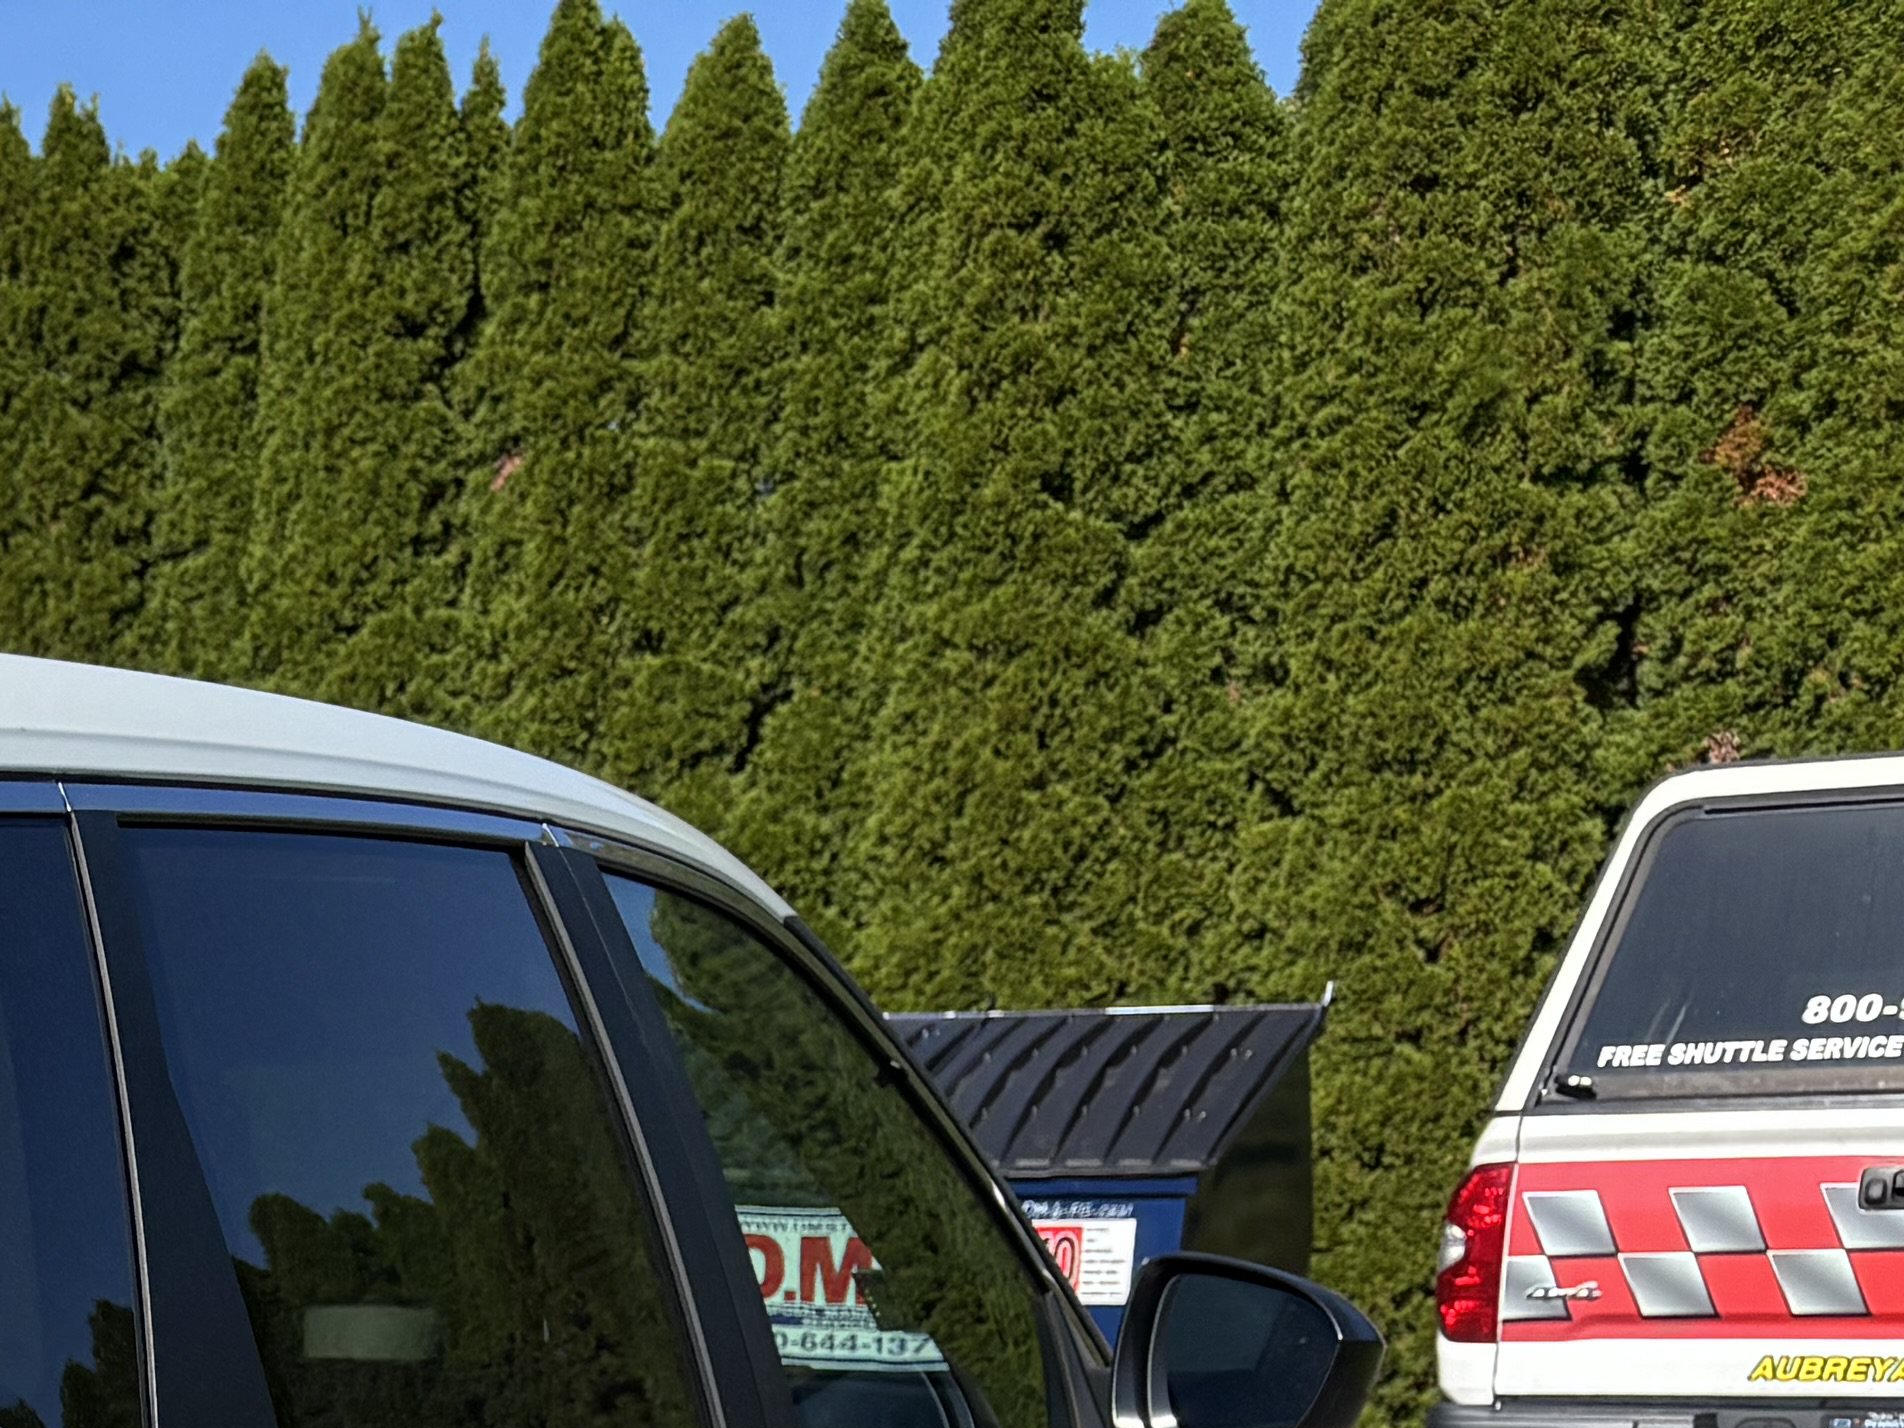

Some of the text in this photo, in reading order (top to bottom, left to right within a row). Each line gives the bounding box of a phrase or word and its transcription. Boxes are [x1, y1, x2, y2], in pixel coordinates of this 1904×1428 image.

[1597, 1034, 1904, 1068] FREE SHUTTLE SERVICE
